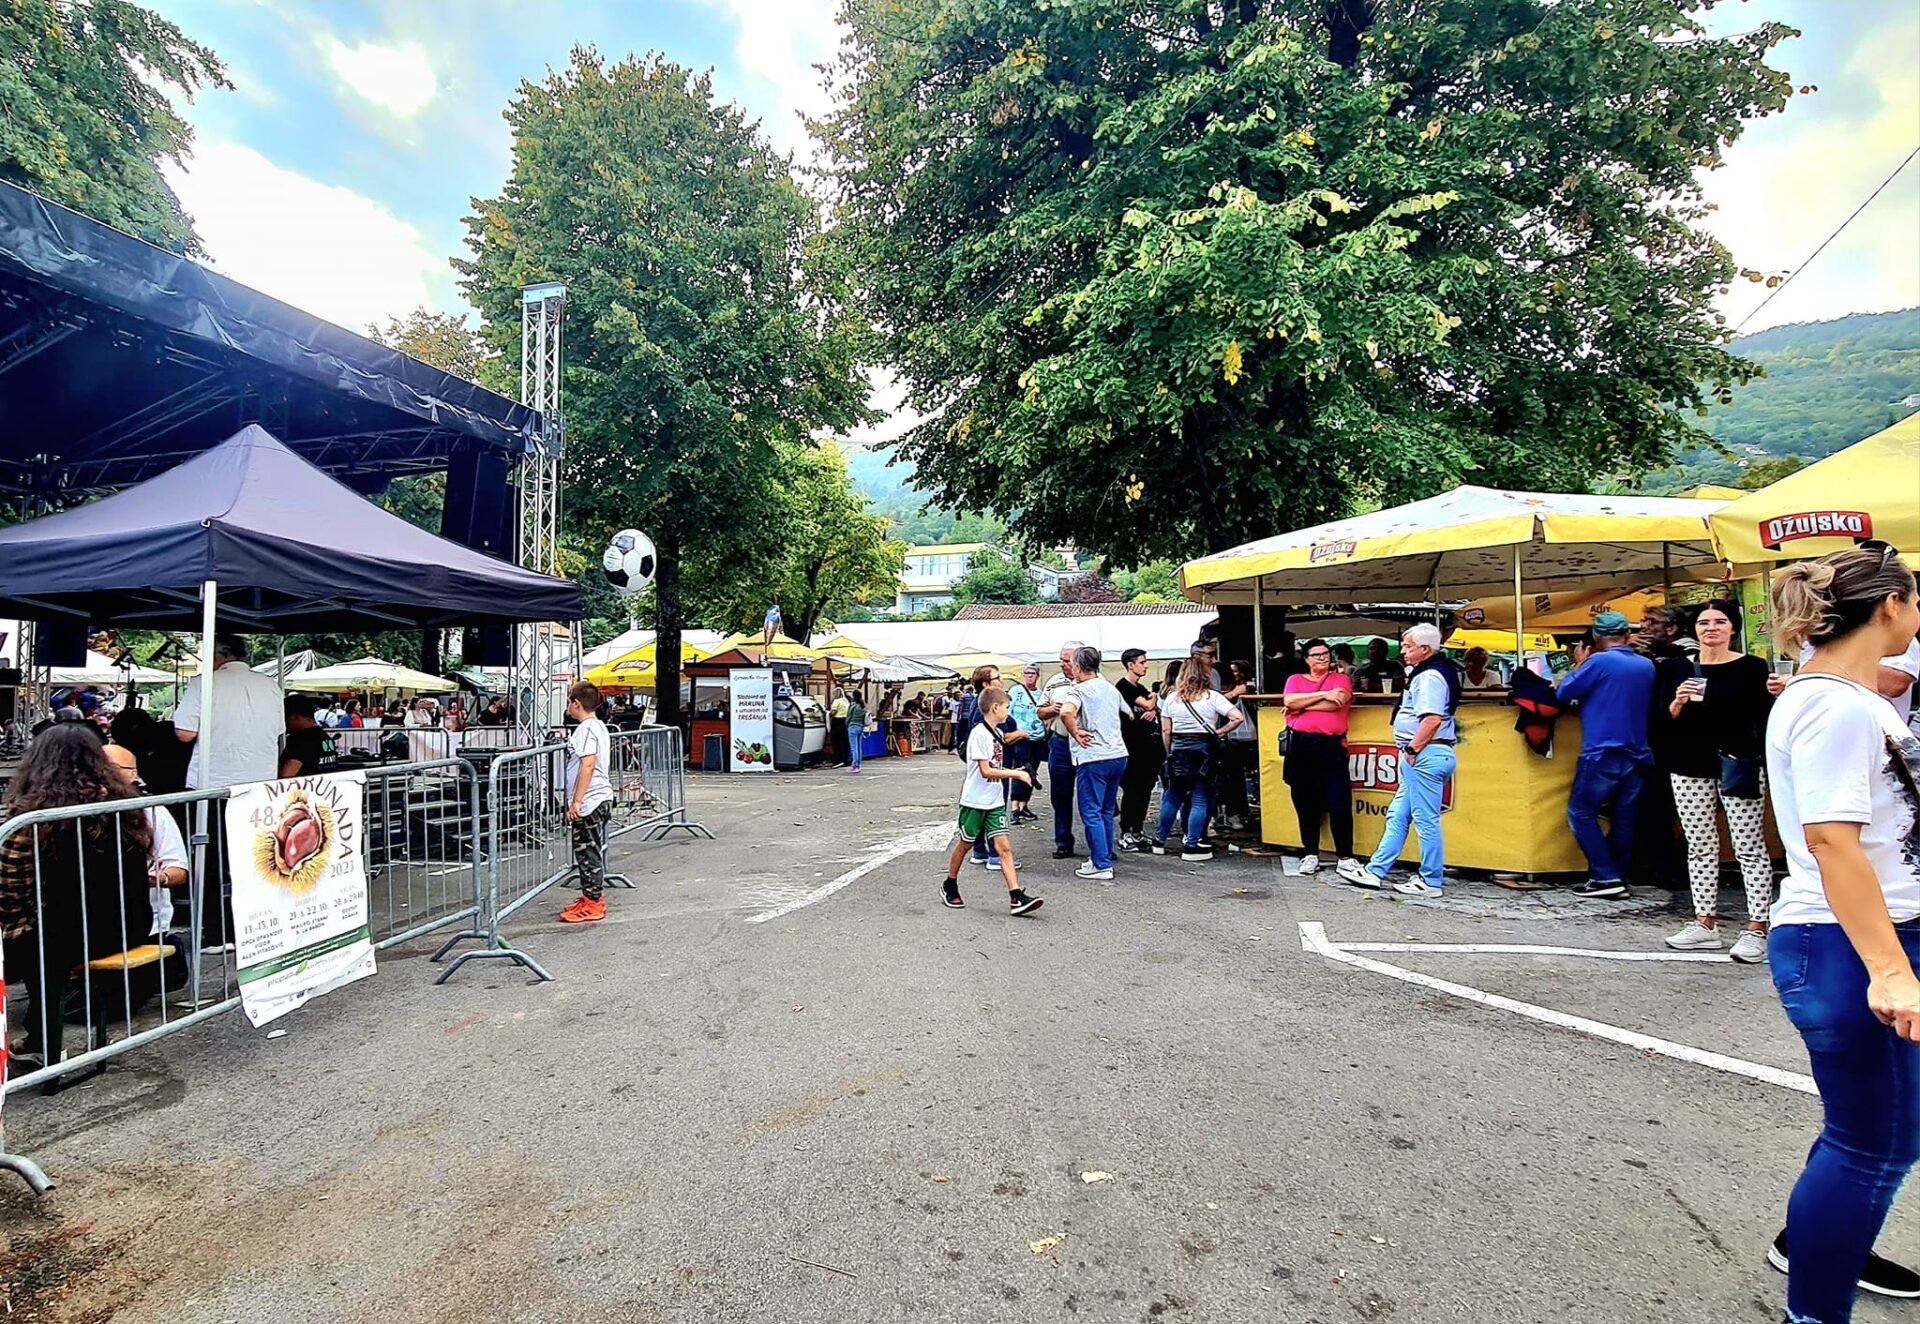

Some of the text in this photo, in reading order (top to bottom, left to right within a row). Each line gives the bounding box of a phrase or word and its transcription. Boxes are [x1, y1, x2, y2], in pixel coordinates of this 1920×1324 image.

[1768, 512, 1862, 541] Ožujsko
[249, 805, 278, 829] 48.
[264, 776, 354, 860] MARUNADA
[330, 860, 354, 878] 2023
